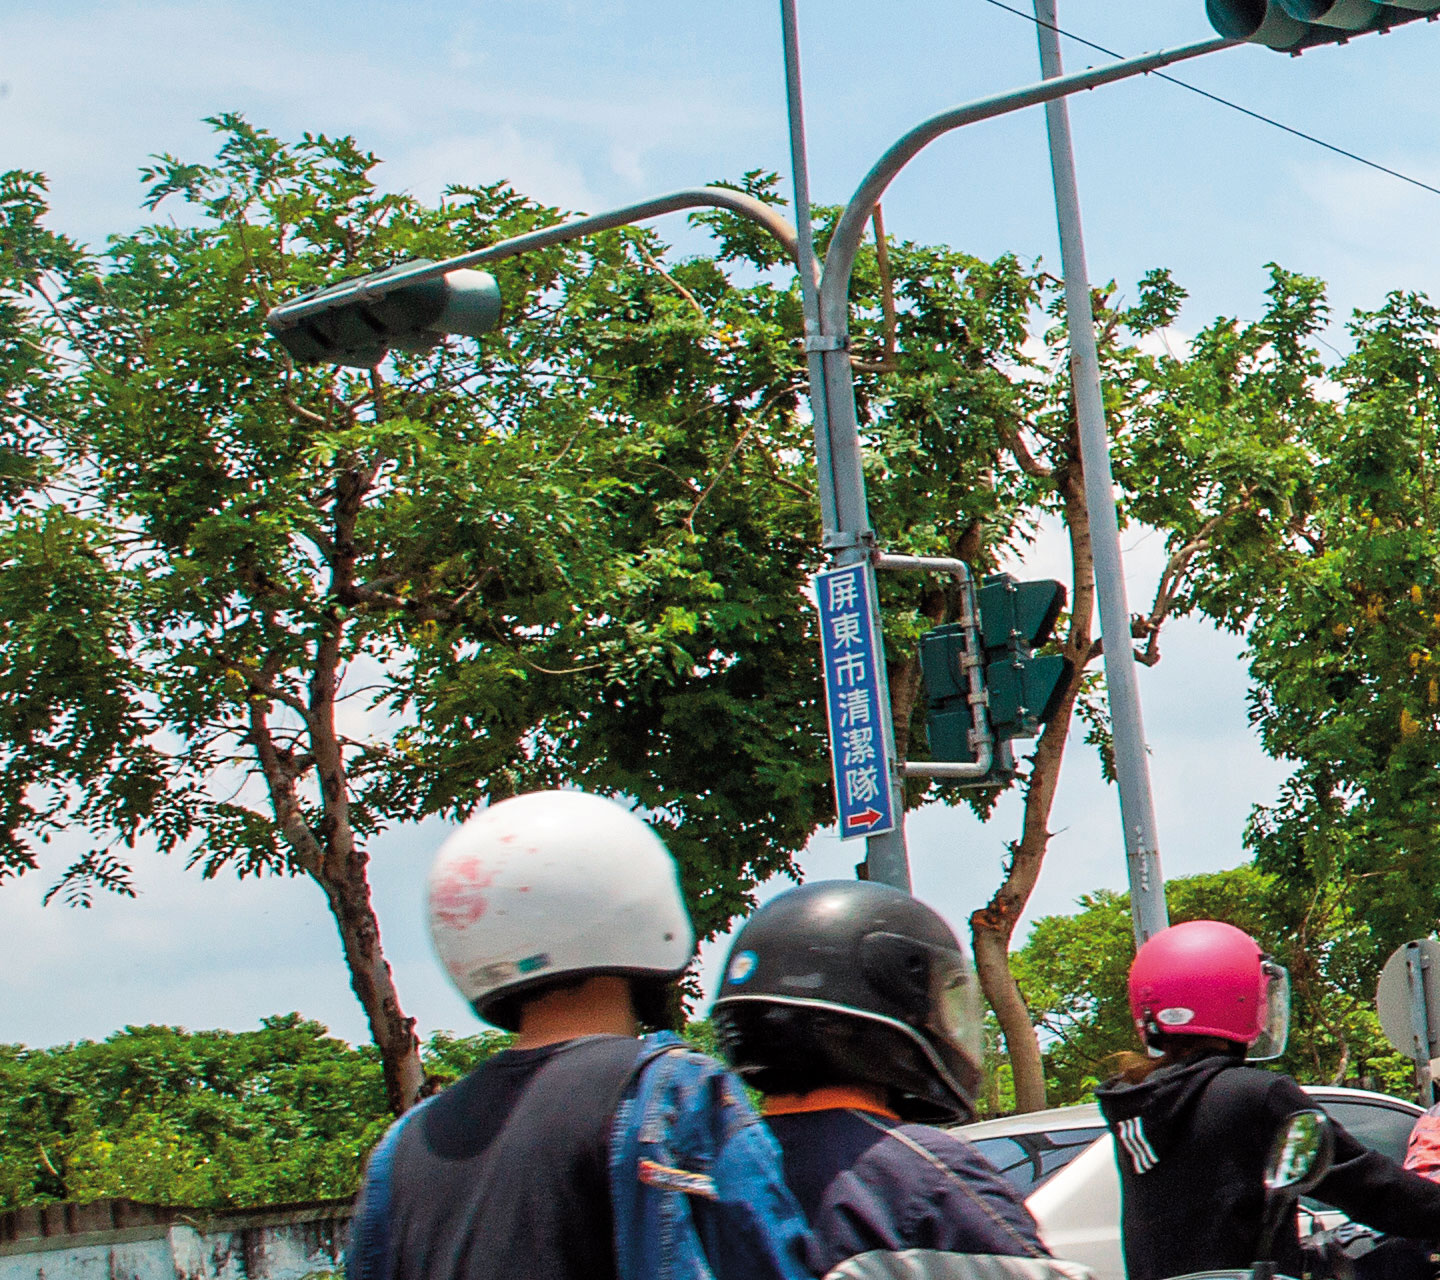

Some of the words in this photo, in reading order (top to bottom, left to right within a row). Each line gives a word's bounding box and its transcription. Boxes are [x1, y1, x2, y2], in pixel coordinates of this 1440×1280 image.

[827, 572, 881, 806] 屏東市清潔隊
